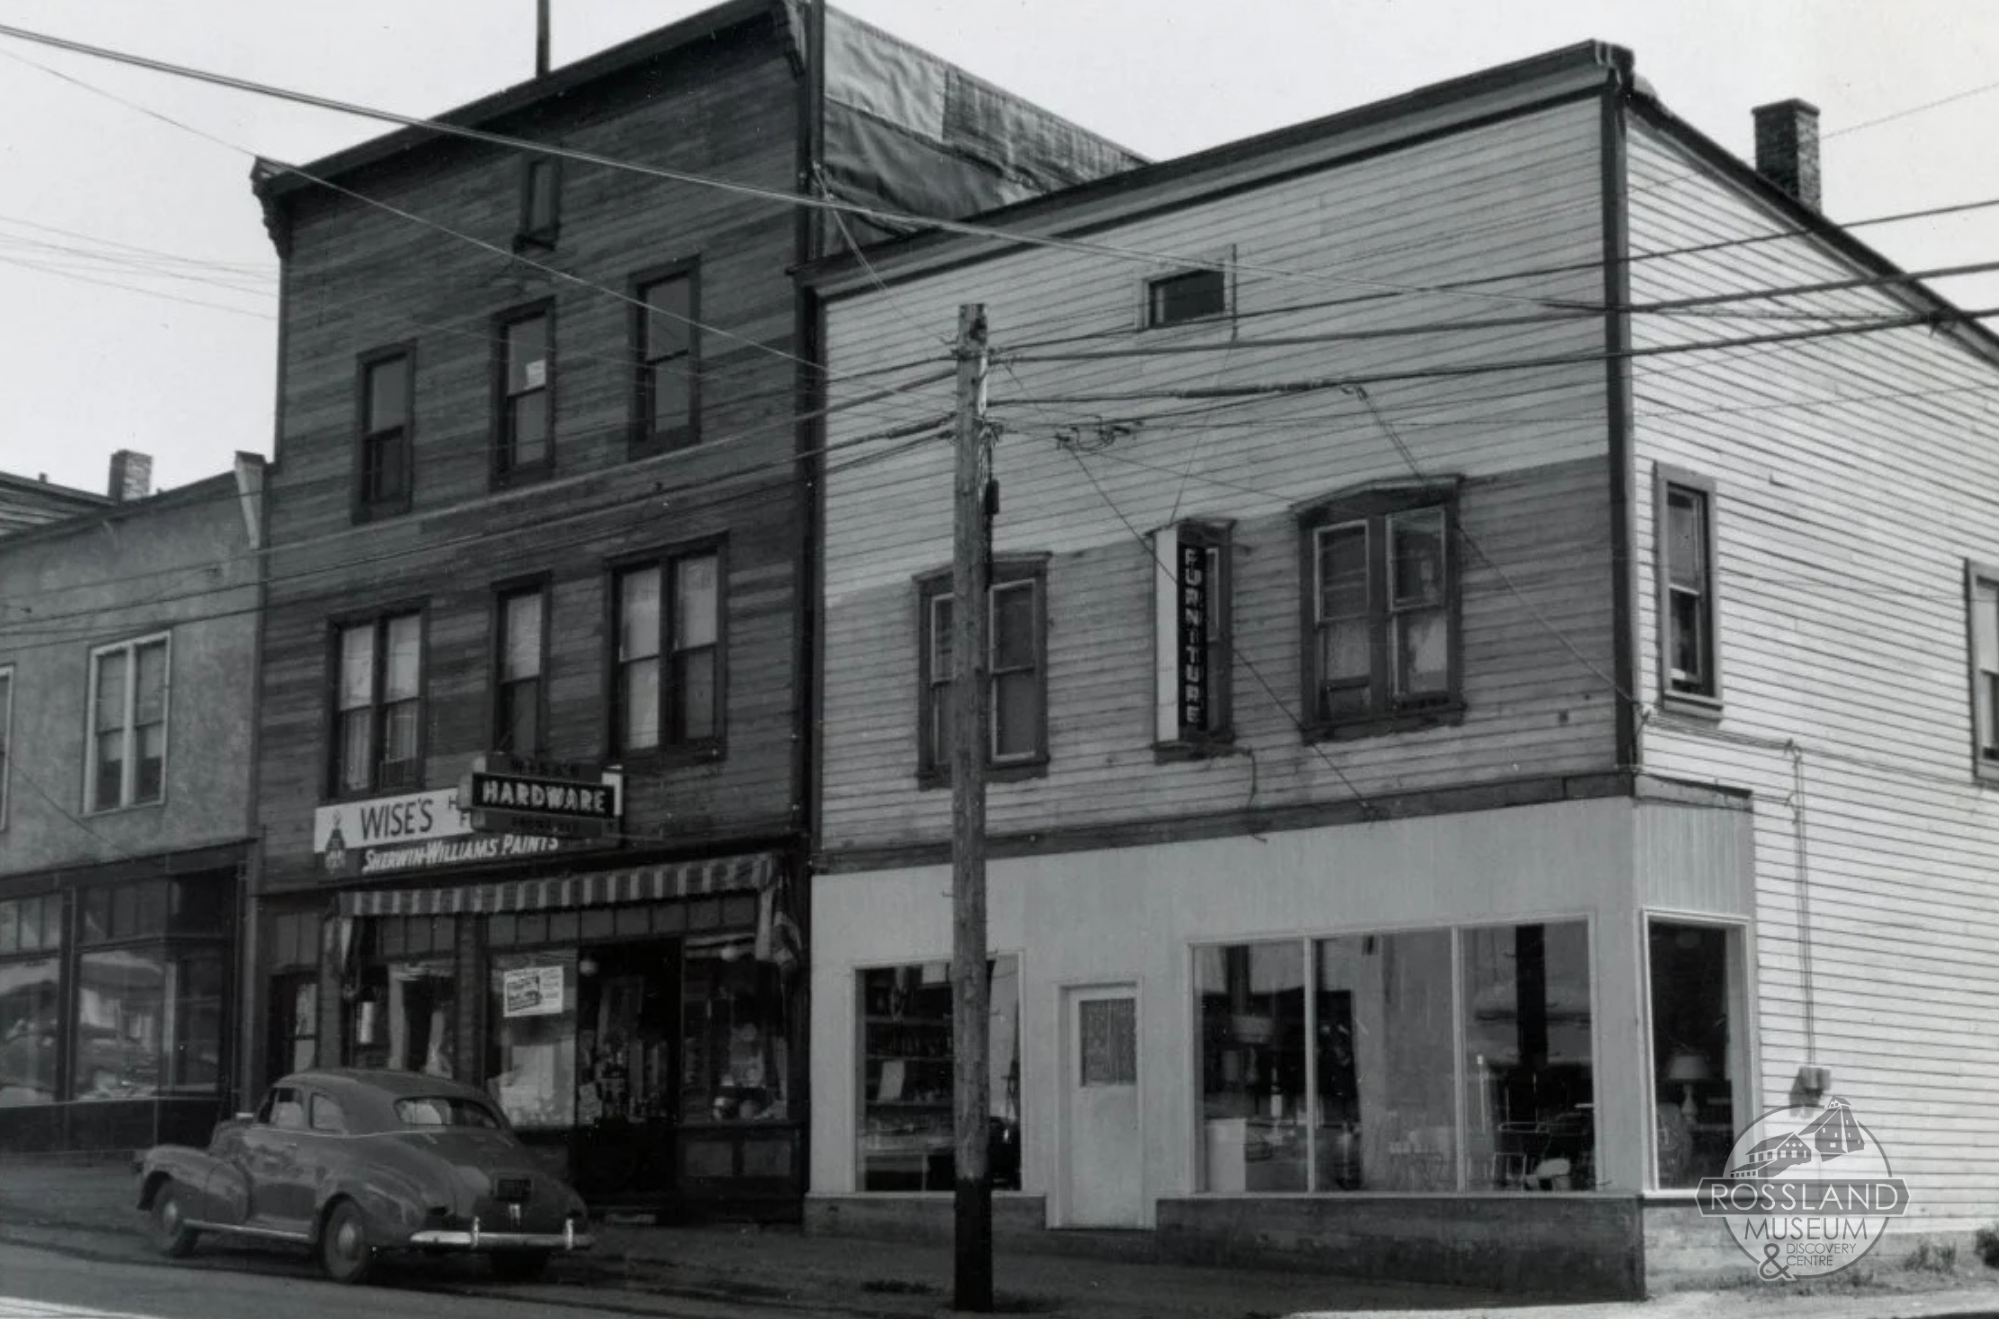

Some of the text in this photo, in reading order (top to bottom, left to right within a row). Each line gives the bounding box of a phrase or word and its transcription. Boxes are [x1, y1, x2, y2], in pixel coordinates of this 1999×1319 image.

[1184, 547, 1202, 724] FURNITURE
[483, 780, 606, 813] HARDWARE
[360, 797, 434, 841] WISE'S
